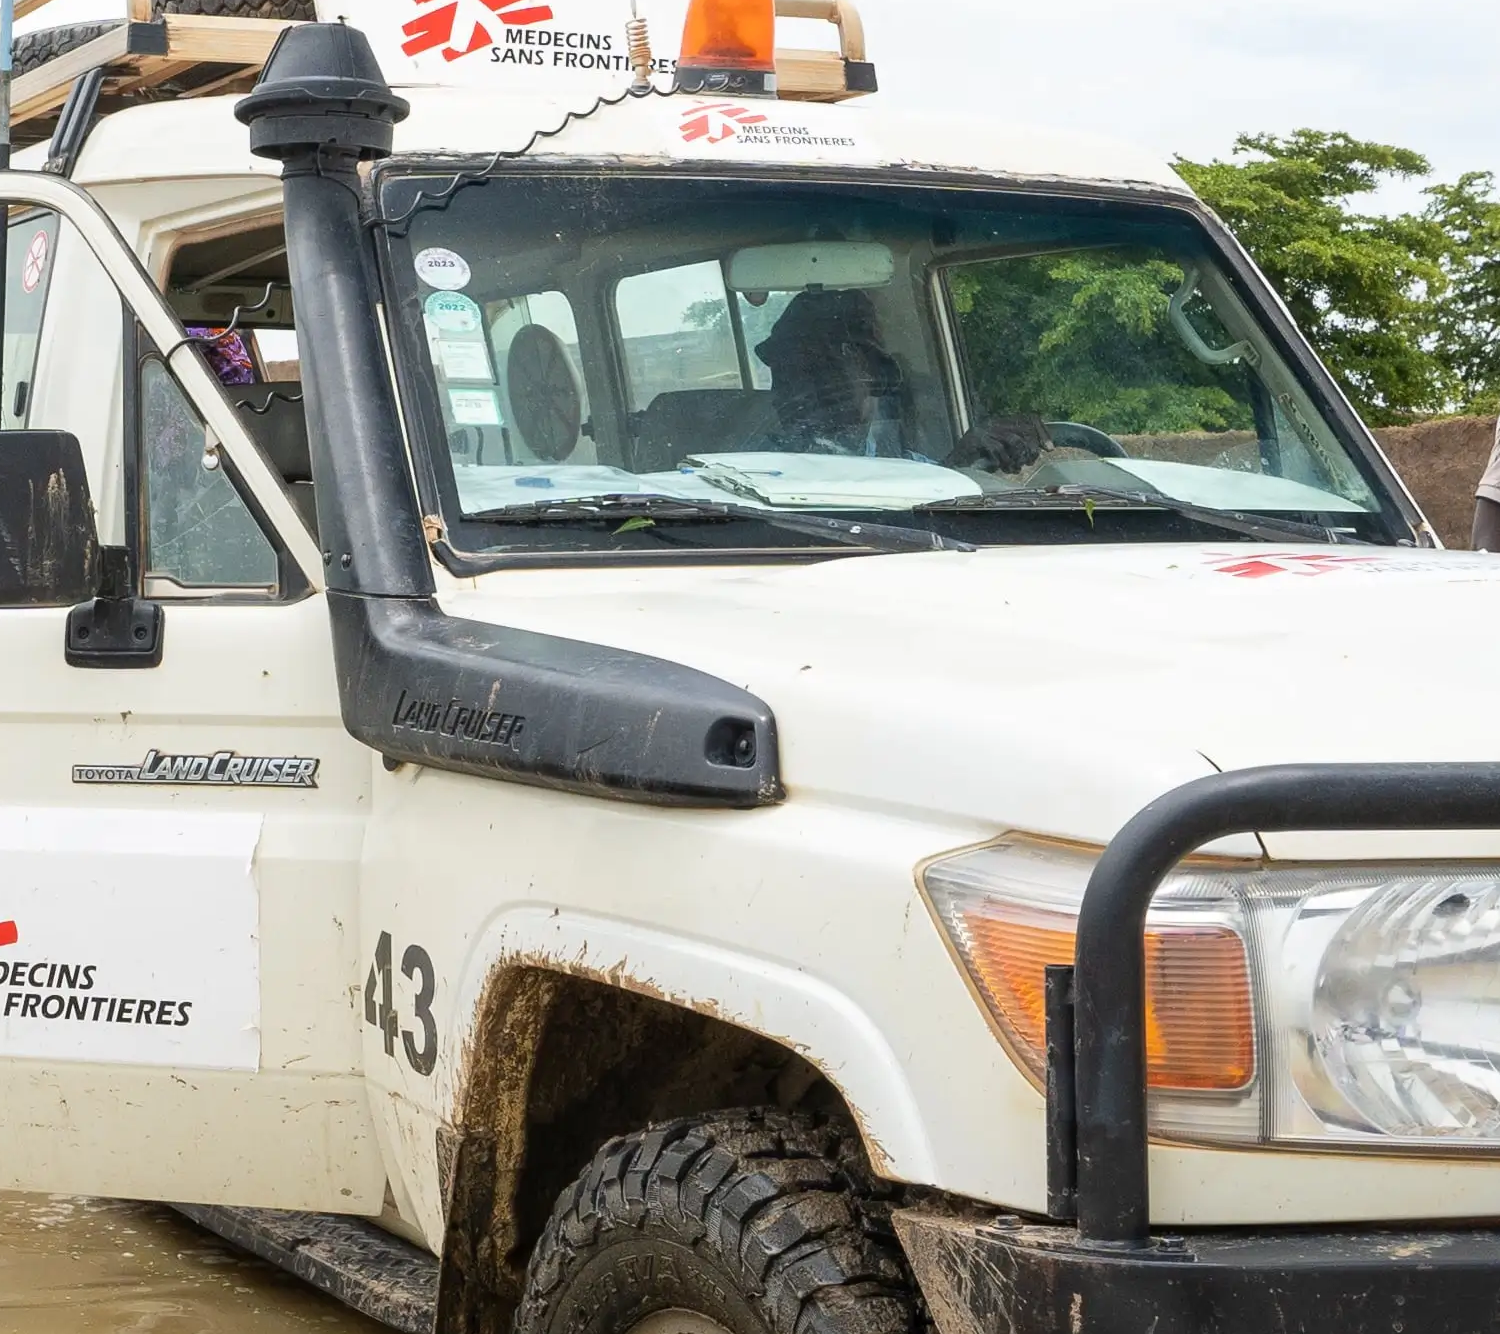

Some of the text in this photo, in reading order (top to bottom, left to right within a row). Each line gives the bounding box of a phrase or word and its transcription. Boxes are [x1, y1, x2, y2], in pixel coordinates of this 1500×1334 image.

[505, 28, 612, 51] MEDECINS
[490, 47, 678, 74] SANS FRONTIRES
[742, 125, 810, 136] MEDECINS
[736, 135, 856, 147] SANS FRONTIERES
[428, 260, 456, 268] 2023
[438, 303, 466, 312] 2022
[76, 768, 134, 781] TOYOTA
[3, 992, 193, 1027] FRONTIERES
[364, 930, 438, 1077] 43
